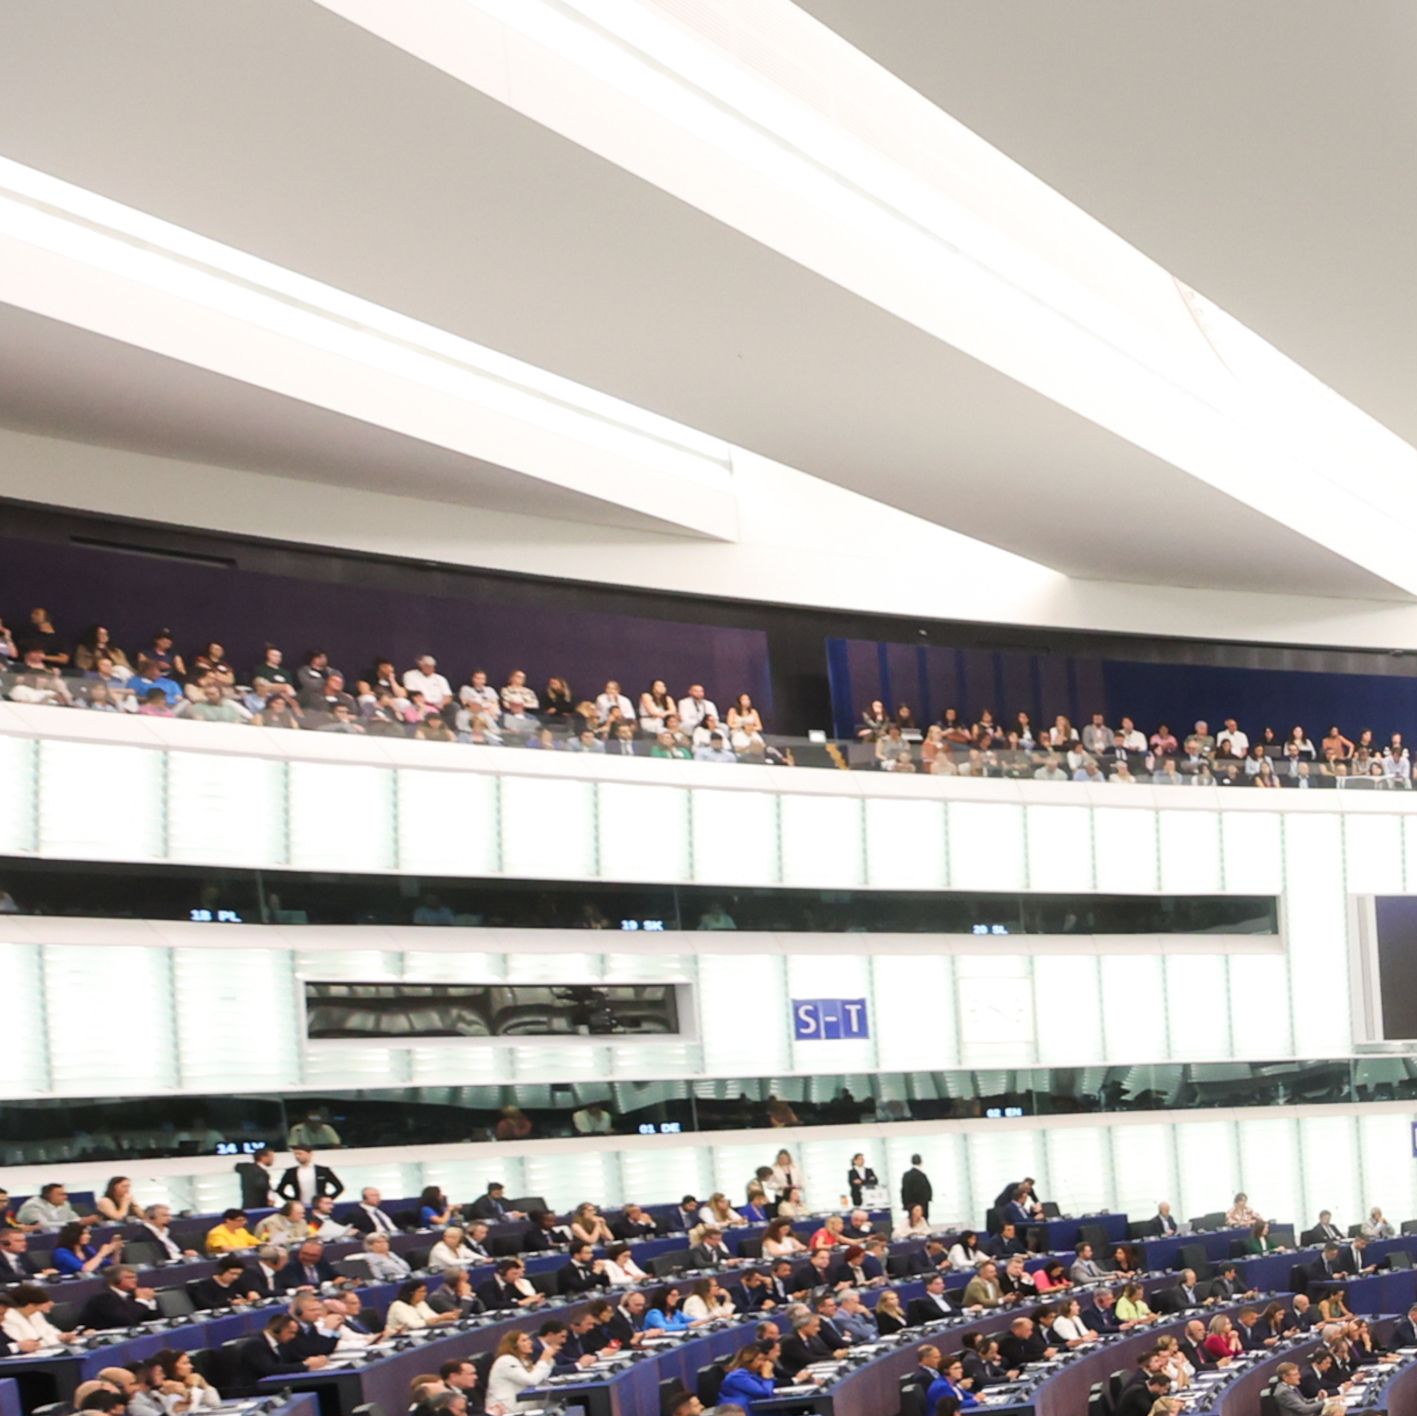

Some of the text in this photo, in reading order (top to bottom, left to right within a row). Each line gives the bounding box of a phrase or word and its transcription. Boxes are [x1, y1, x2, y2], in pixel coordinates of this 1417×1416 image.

[217, 910, 242, 922] PL
[643, 919, 663, 931] SK
[798, 1004, 863, 1034] S-T
[986, 1107, 1022, 1118] 02 EN
[639, 1123, 680, 1135] 01 DE
[217, 1143, 236, 1155] 14
